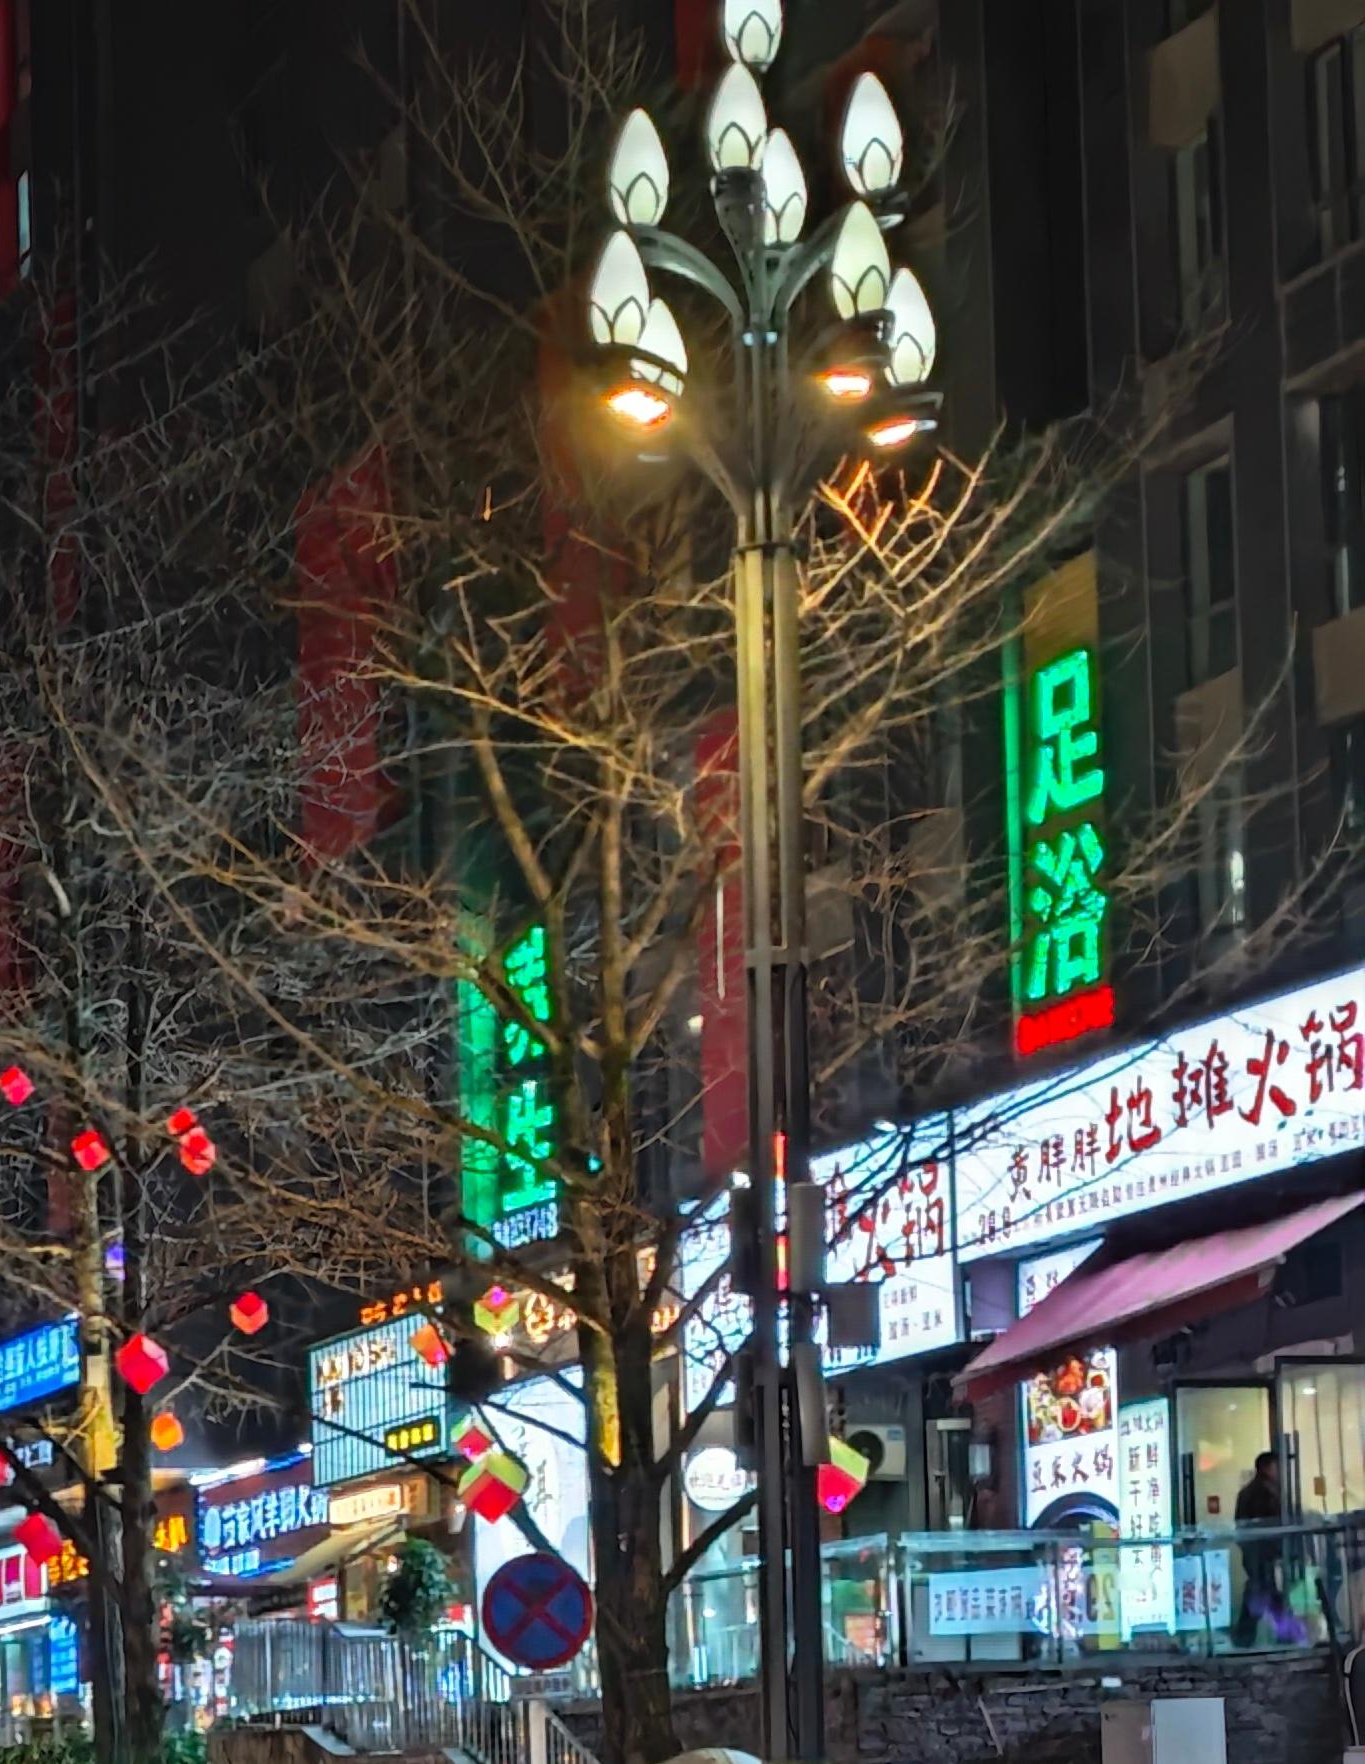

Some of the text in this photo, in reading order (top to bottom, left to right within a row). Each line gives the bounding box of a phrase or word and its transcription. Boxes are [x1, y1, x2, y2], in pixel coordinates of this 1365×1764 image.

[1027, 648, 1106, 1002] 足浴
[1007, 1000, 1365, 1203] 黄胖胖地摊火锅
